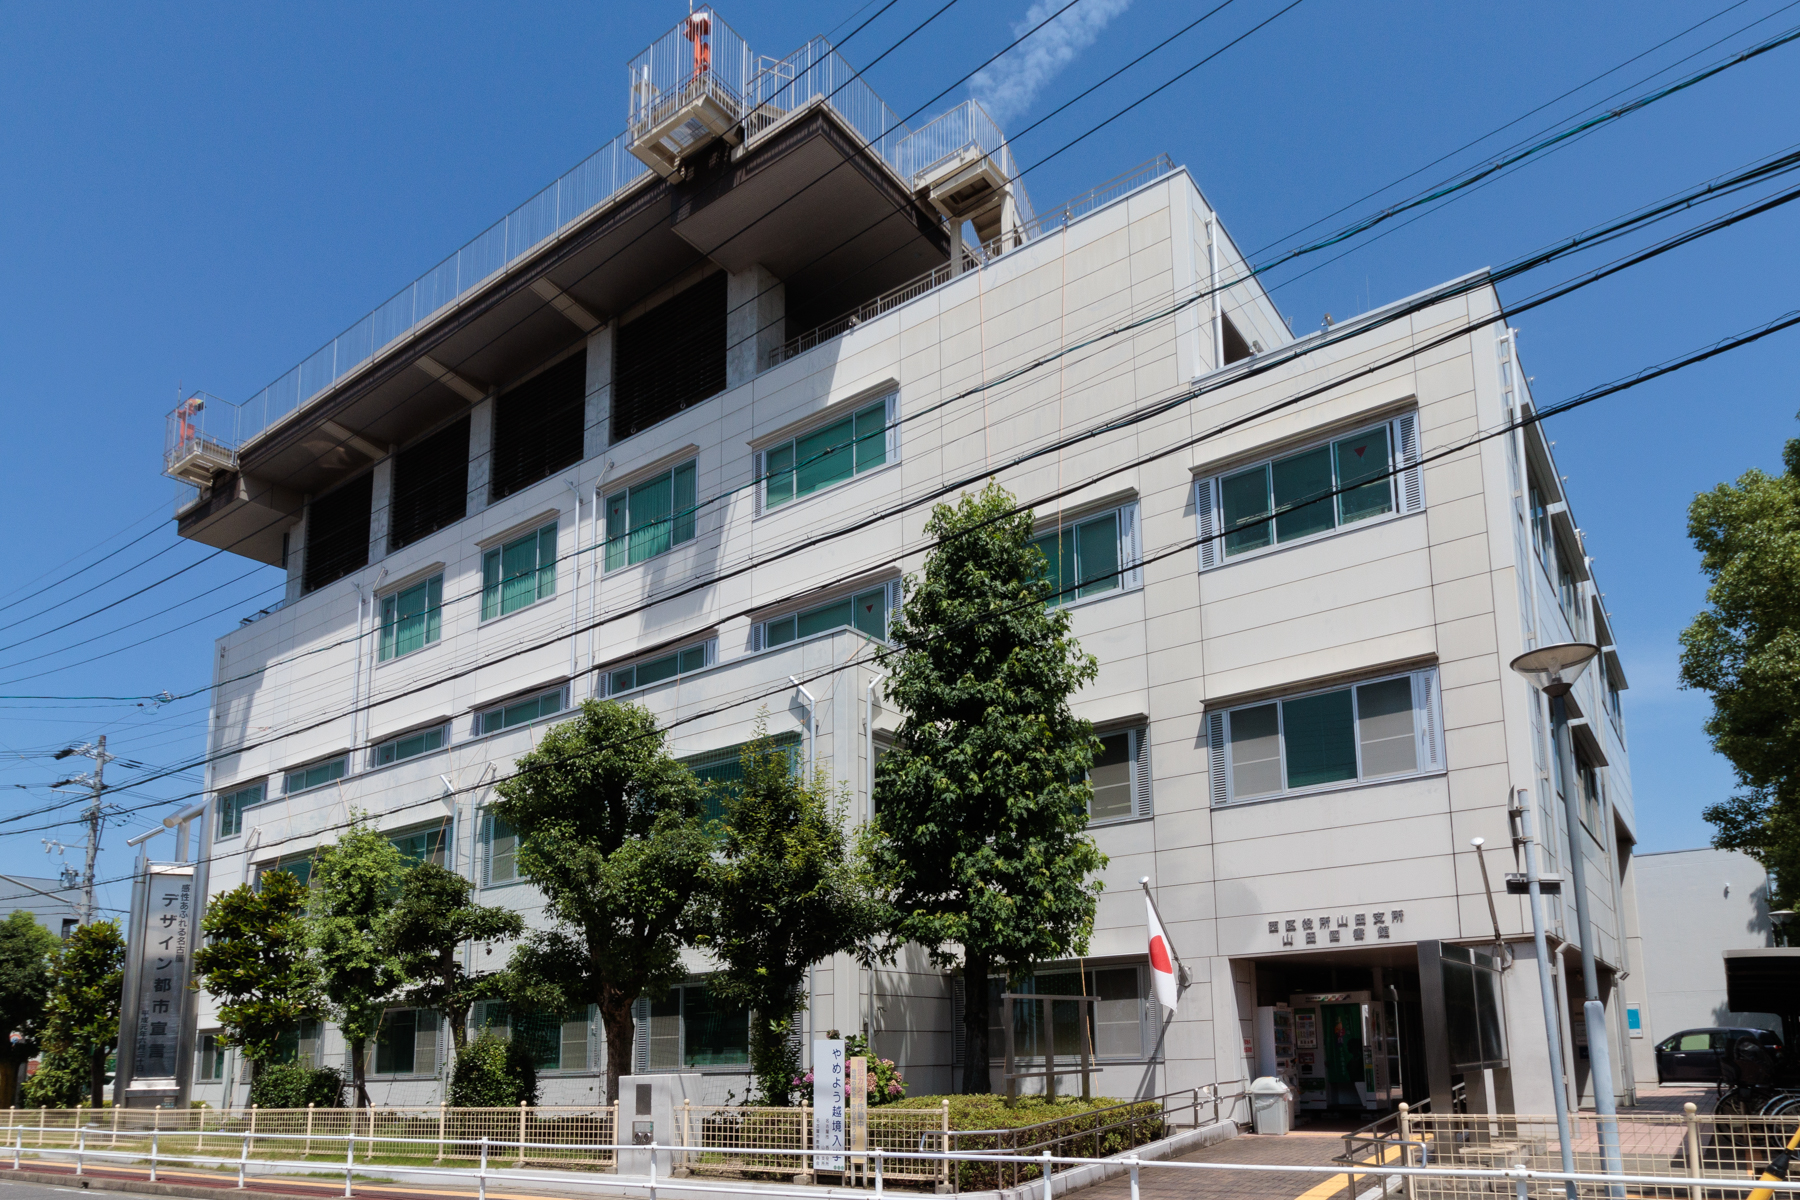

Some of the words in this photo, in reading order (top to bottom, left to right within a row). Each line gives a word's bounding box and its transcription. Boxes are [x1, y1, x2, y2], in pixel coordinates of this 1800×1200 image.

[175, 883, 191, 963] 感性あふれる名古屋
[1268, 909, 1404, 934] 西区役所山田支所
[1282, 925, 1390, 947] 山田図書館
[148, 892, 180, 1059] デザイン都市宣言
